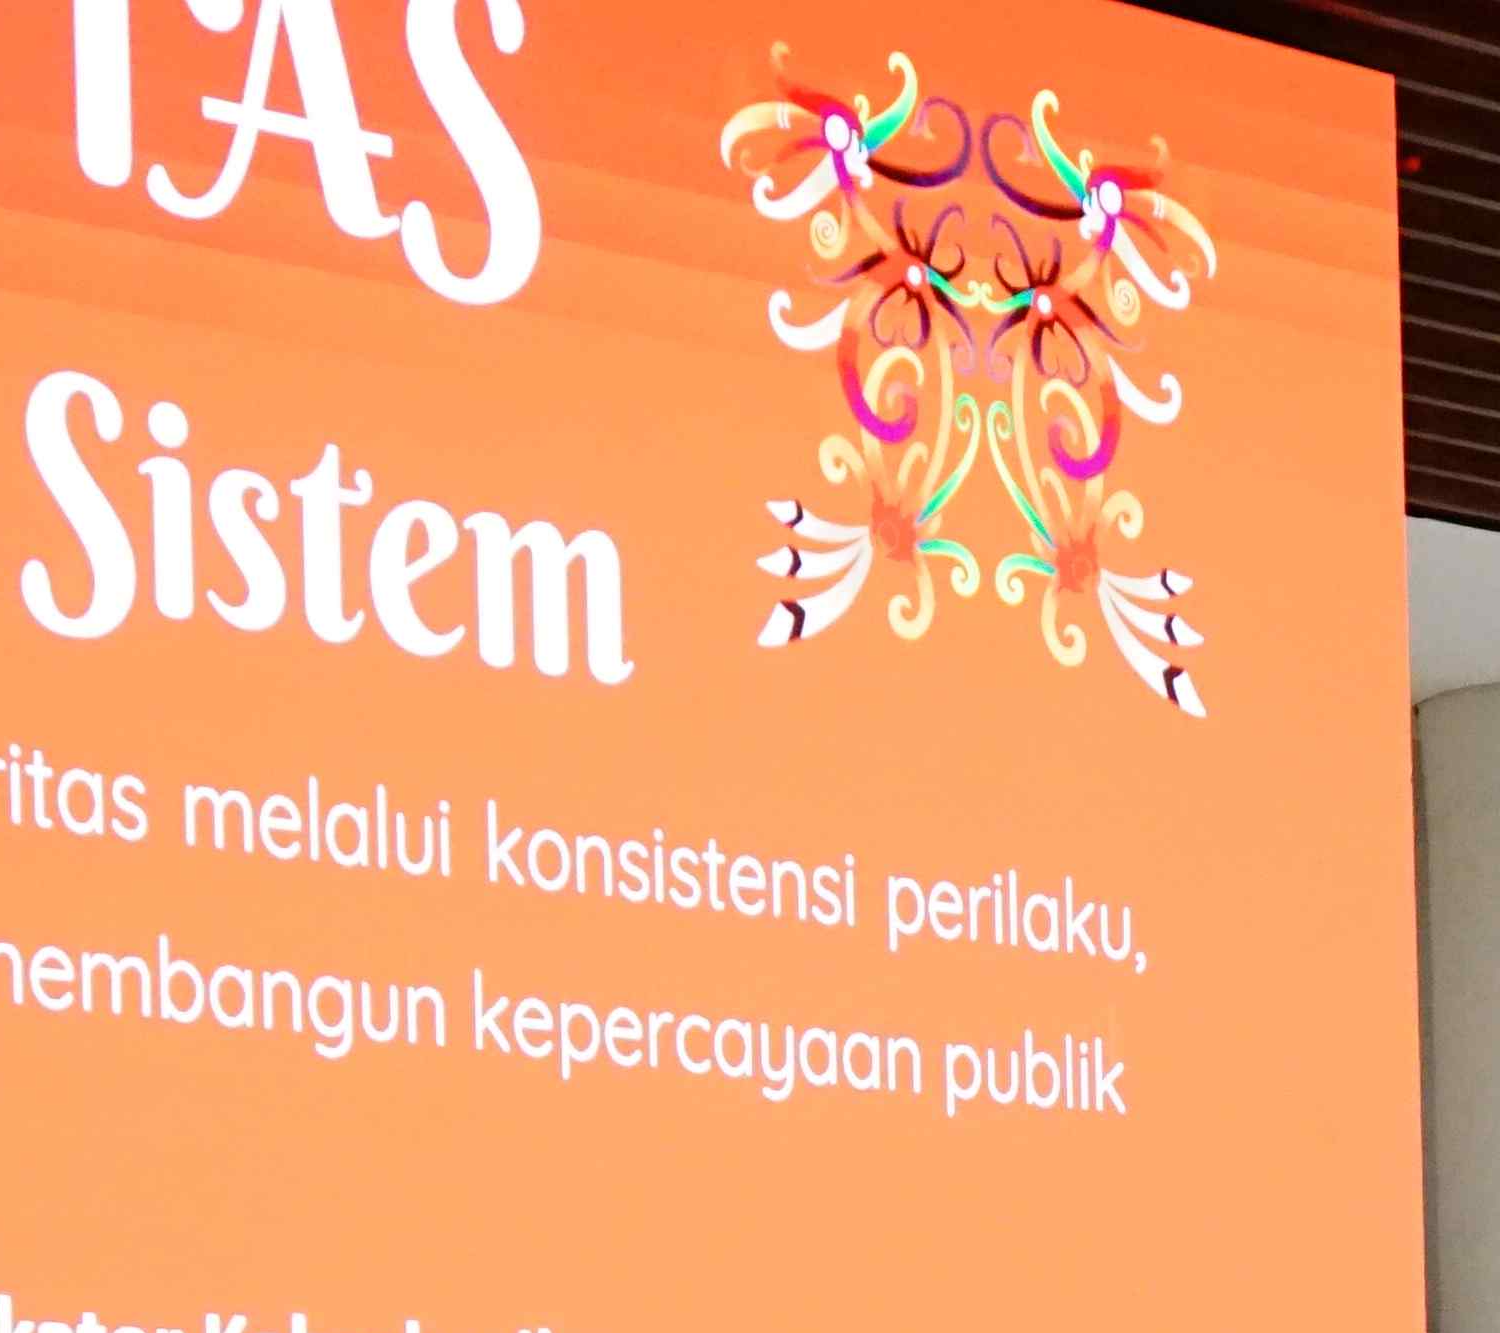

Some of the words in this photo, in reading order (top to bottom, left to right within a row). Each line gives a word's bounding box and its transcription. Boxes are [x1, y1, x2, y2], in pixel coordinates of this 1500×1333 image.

[19, 369, 636, 686] Sistem
[183, 774, 452, 878] melalui
[485, 798, 856, 928] konsistensi
[886, 868, 1148, 975] perilaku,
[472, 967, 923, 1103] kepercayaan
[944, 1028, 1127, 1118] publik
